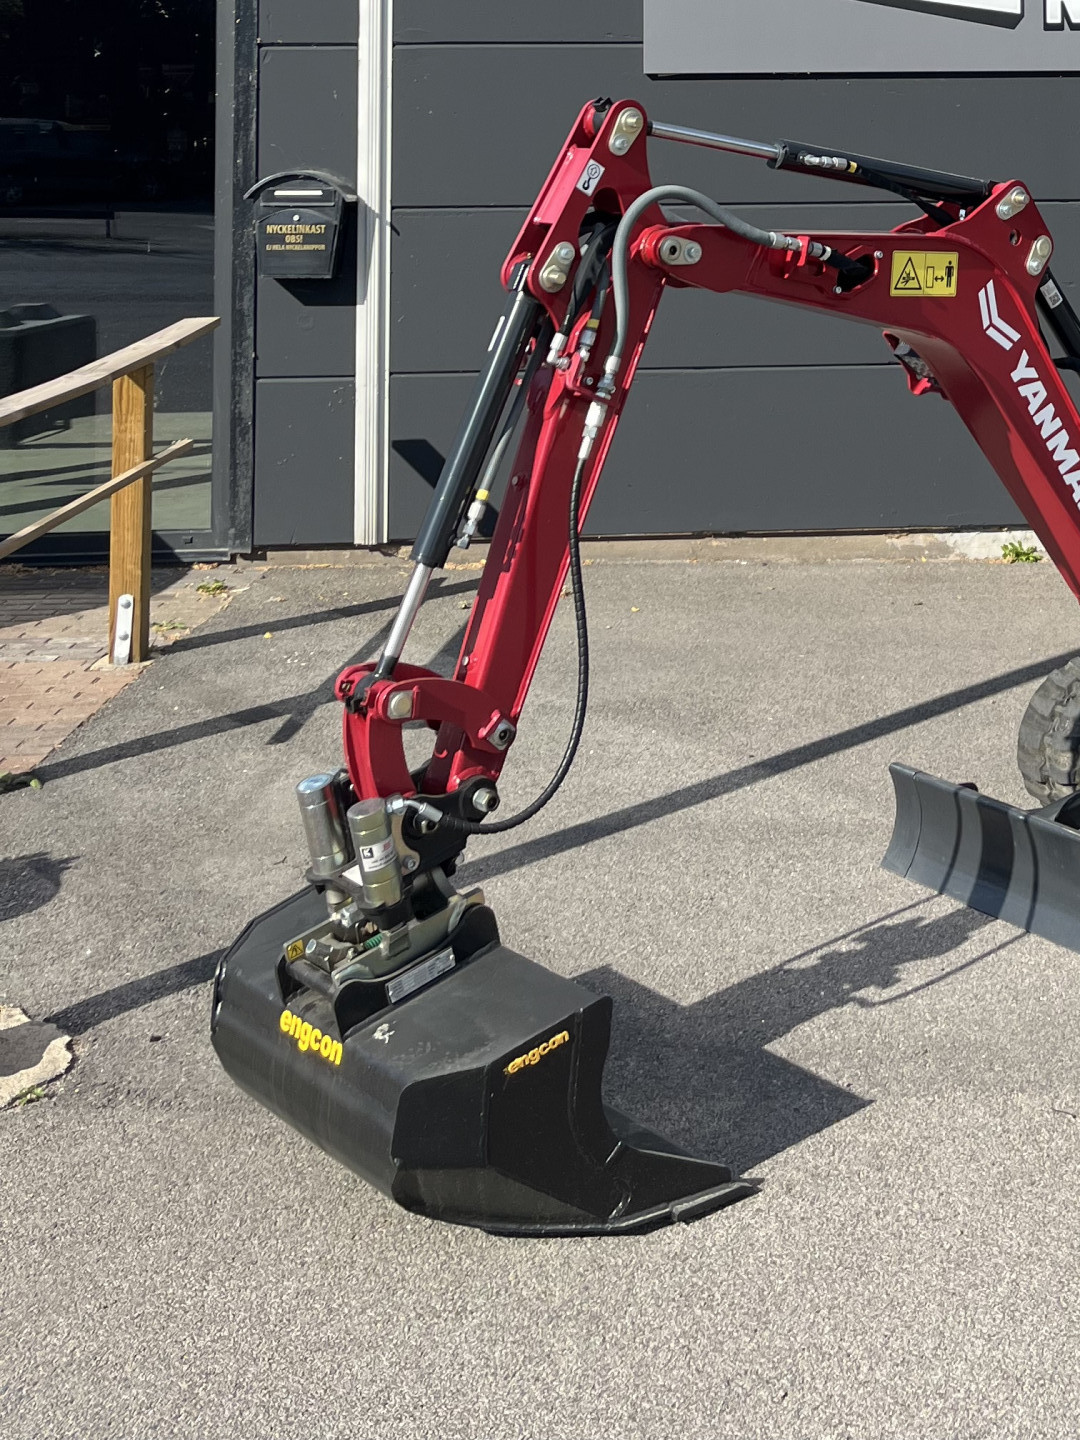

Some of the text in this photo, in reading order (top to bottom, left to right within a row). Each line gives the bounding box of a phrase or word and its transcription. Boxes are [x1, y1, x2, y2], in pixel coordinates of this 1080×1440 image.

[285, 234, 303, 243] OBS!
[279, 1009, 343, 1066] engcon
[507, 1030, 570, 1074] engcon
